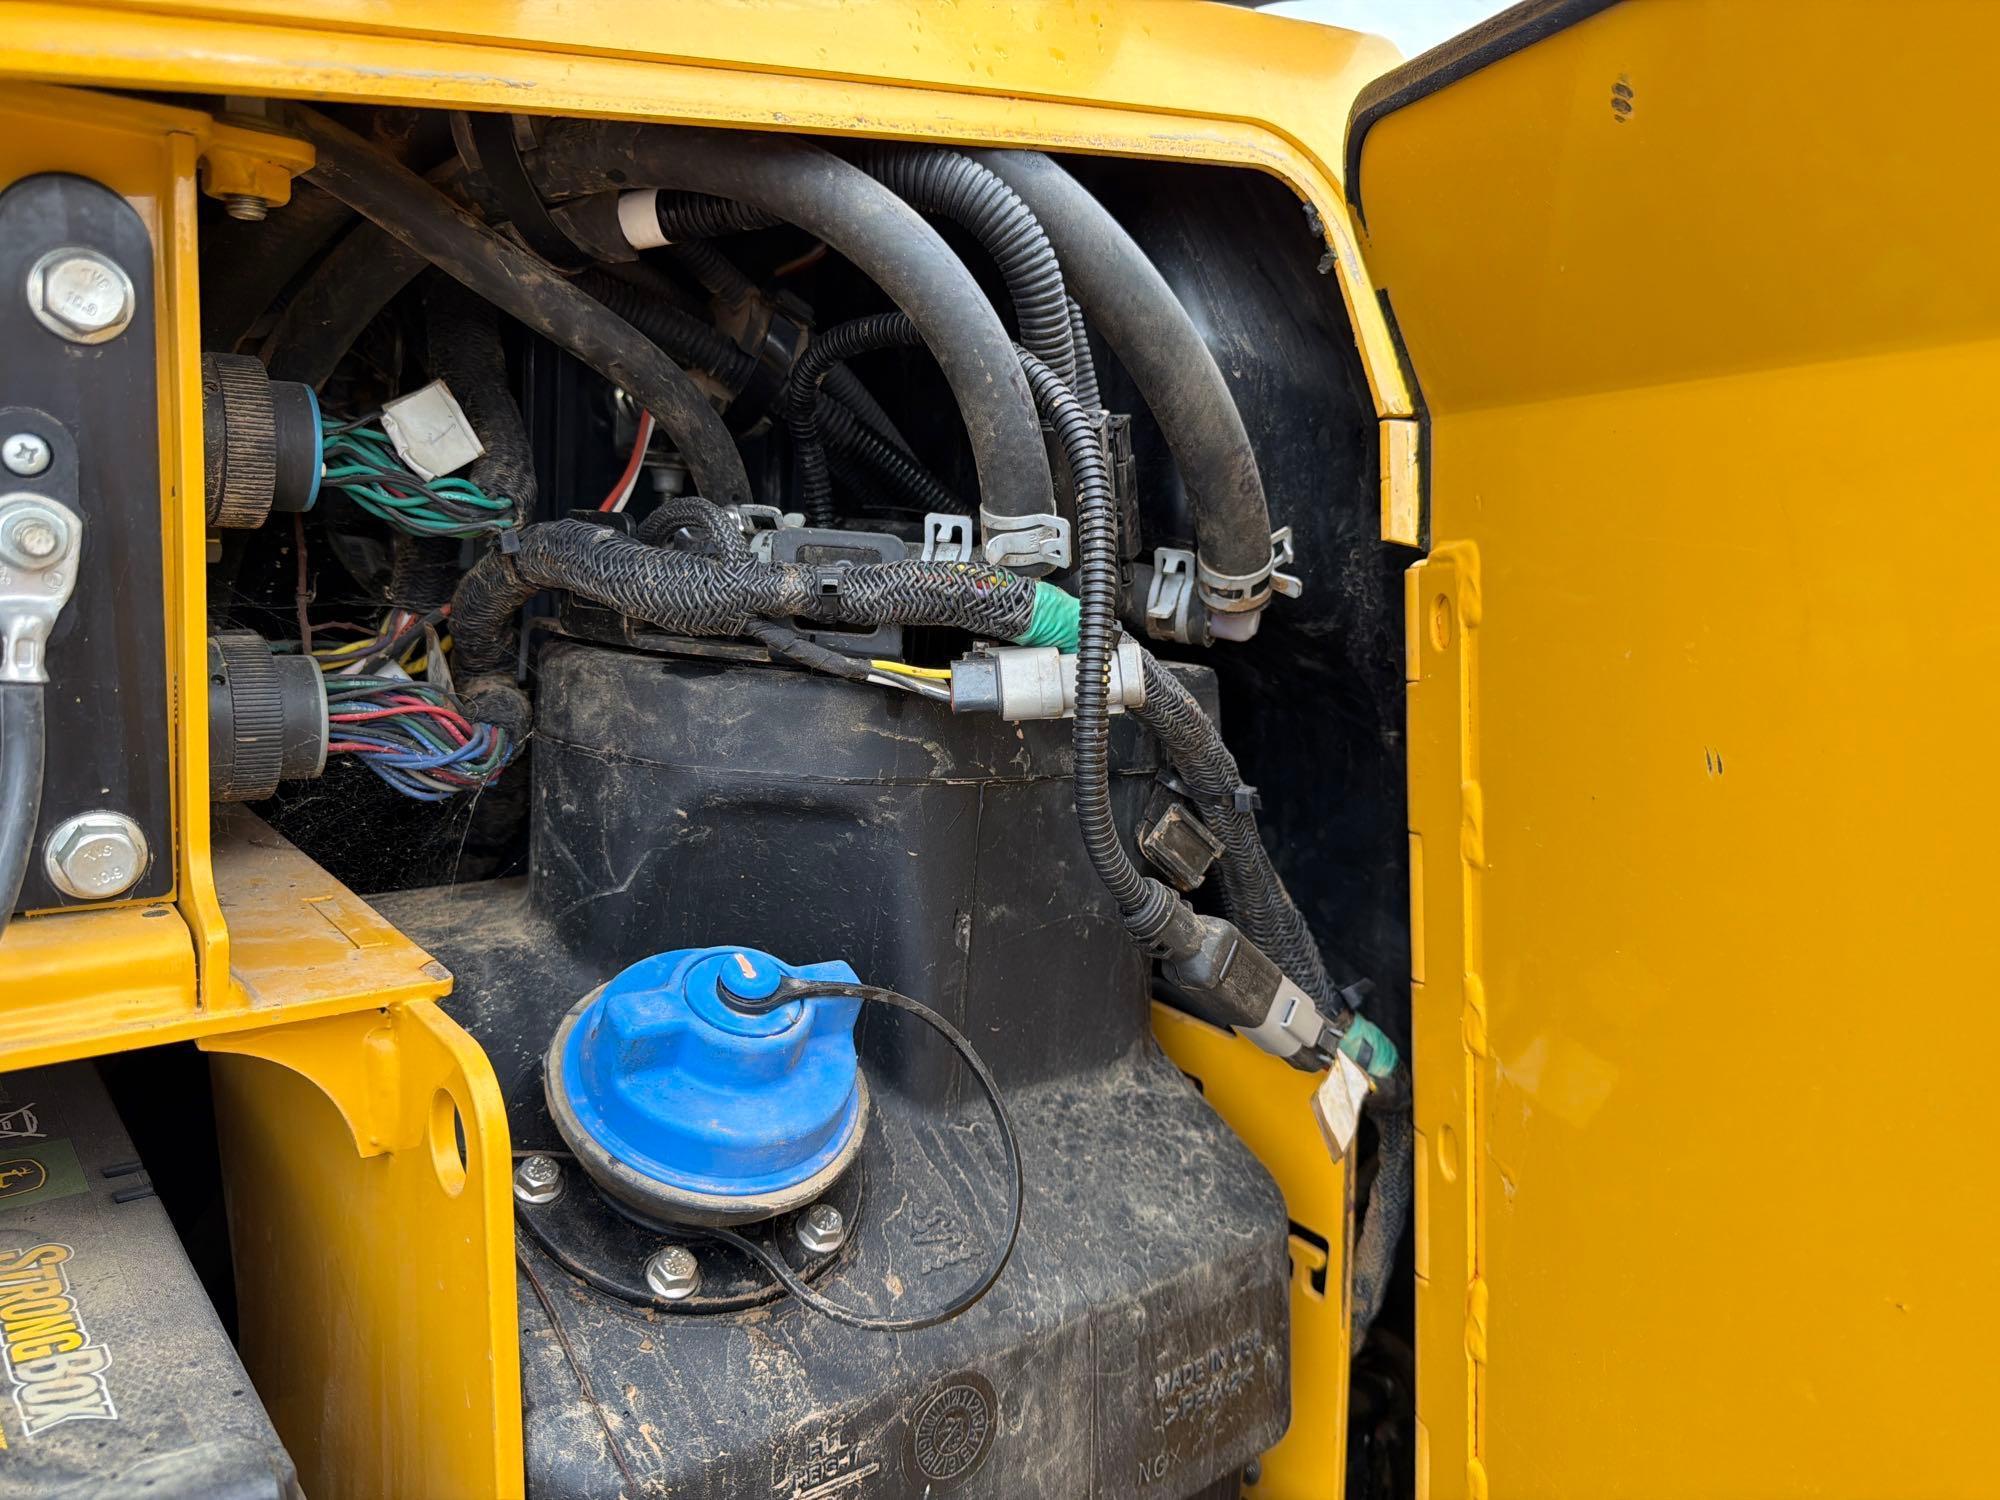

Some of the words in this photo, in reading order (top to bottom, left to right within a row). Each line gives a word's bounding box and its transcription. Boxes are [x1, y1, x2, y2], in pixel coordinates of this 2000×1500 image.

[0, 1243, 108, 1431] STRONGBOX
[1154, 1357, 1205, 1400] MADE
[1207, 1348, 1227, 1372] IN
